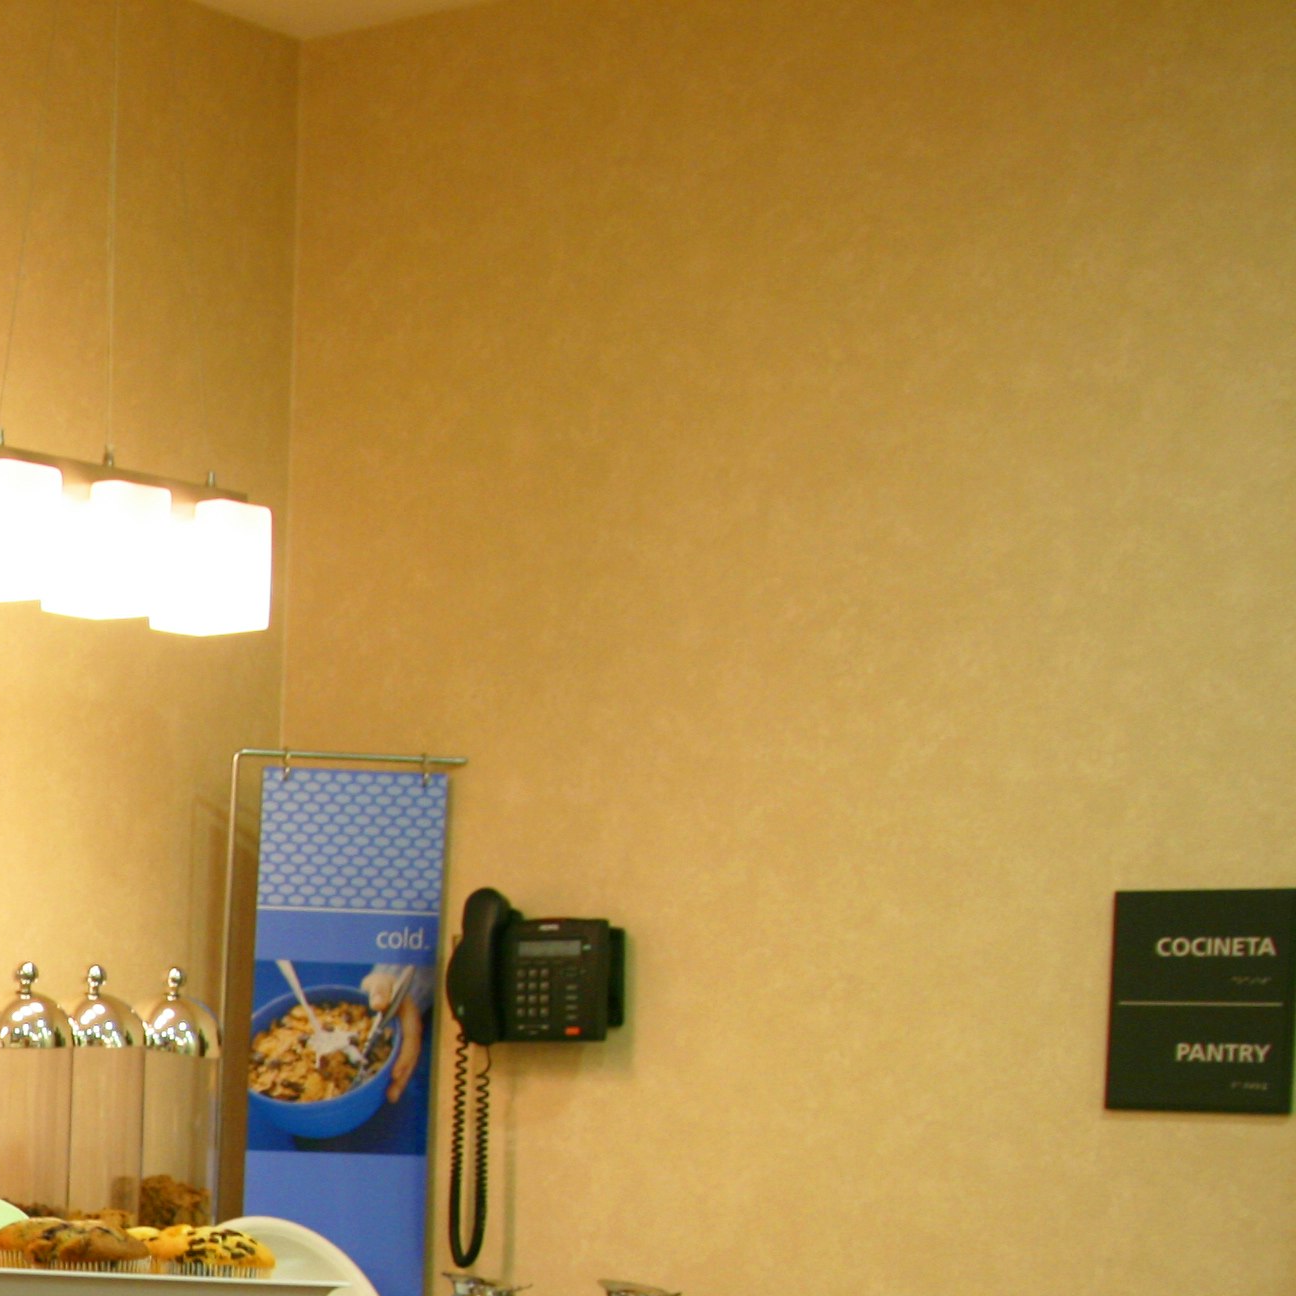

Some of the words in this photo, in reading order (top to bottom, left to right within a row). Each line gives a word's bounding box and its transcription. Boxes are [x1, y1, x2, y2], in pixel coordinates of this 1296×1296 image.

[375, 926, 430, 950] cold.
[1156, 936, 1277, 957] COCINETA
[1175, 1042, 1272, 1063] PANTRY
